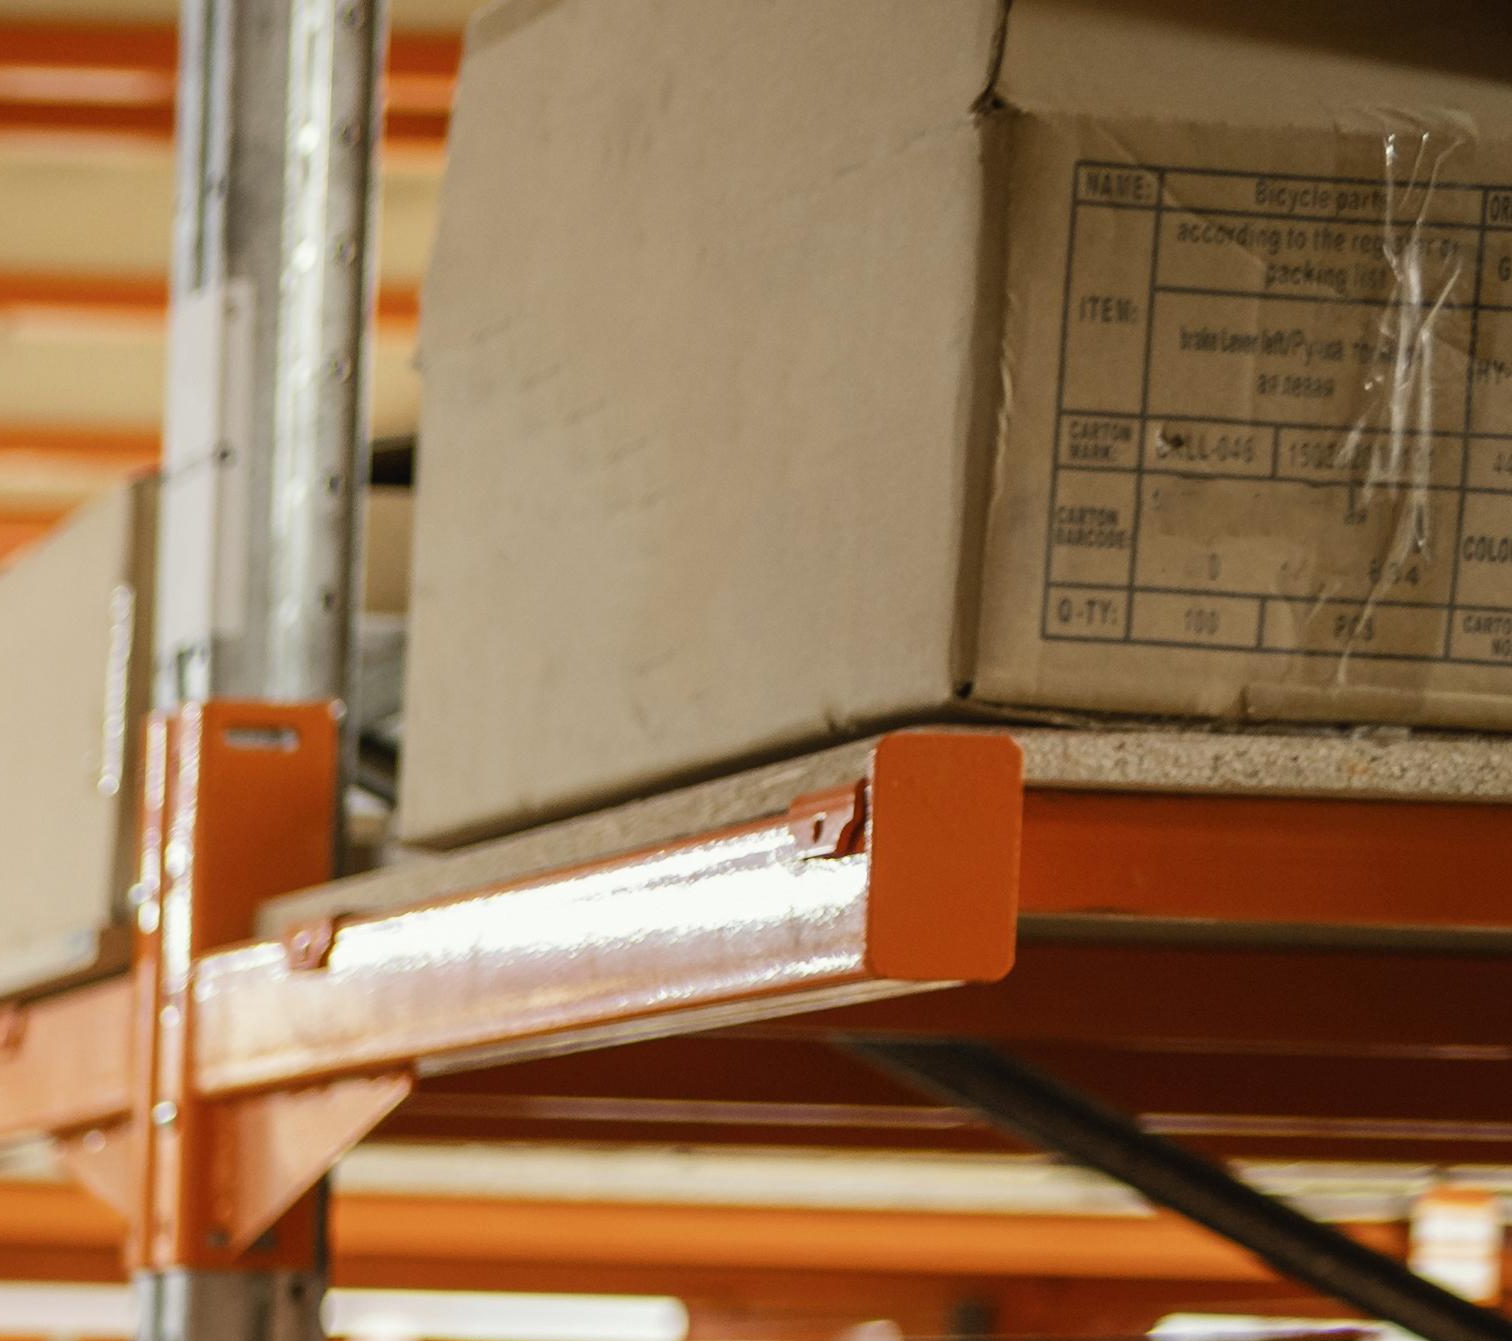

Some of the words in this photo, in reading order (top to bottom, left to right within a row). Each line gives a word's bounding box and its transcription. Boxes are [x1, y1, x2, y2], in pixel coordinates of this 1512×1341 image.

[1085, 170, 1153, 201] NAME:
[1255, 178, 1330, 214] Bicycle
[1176, 222, 1281, 255] according
[1287, 226, 1307, 250] to
[1312, 228, 1345, 253] the
[1264, 261, 1347, 295] packing
[1079, 294, 1139, 325] ITEM:
